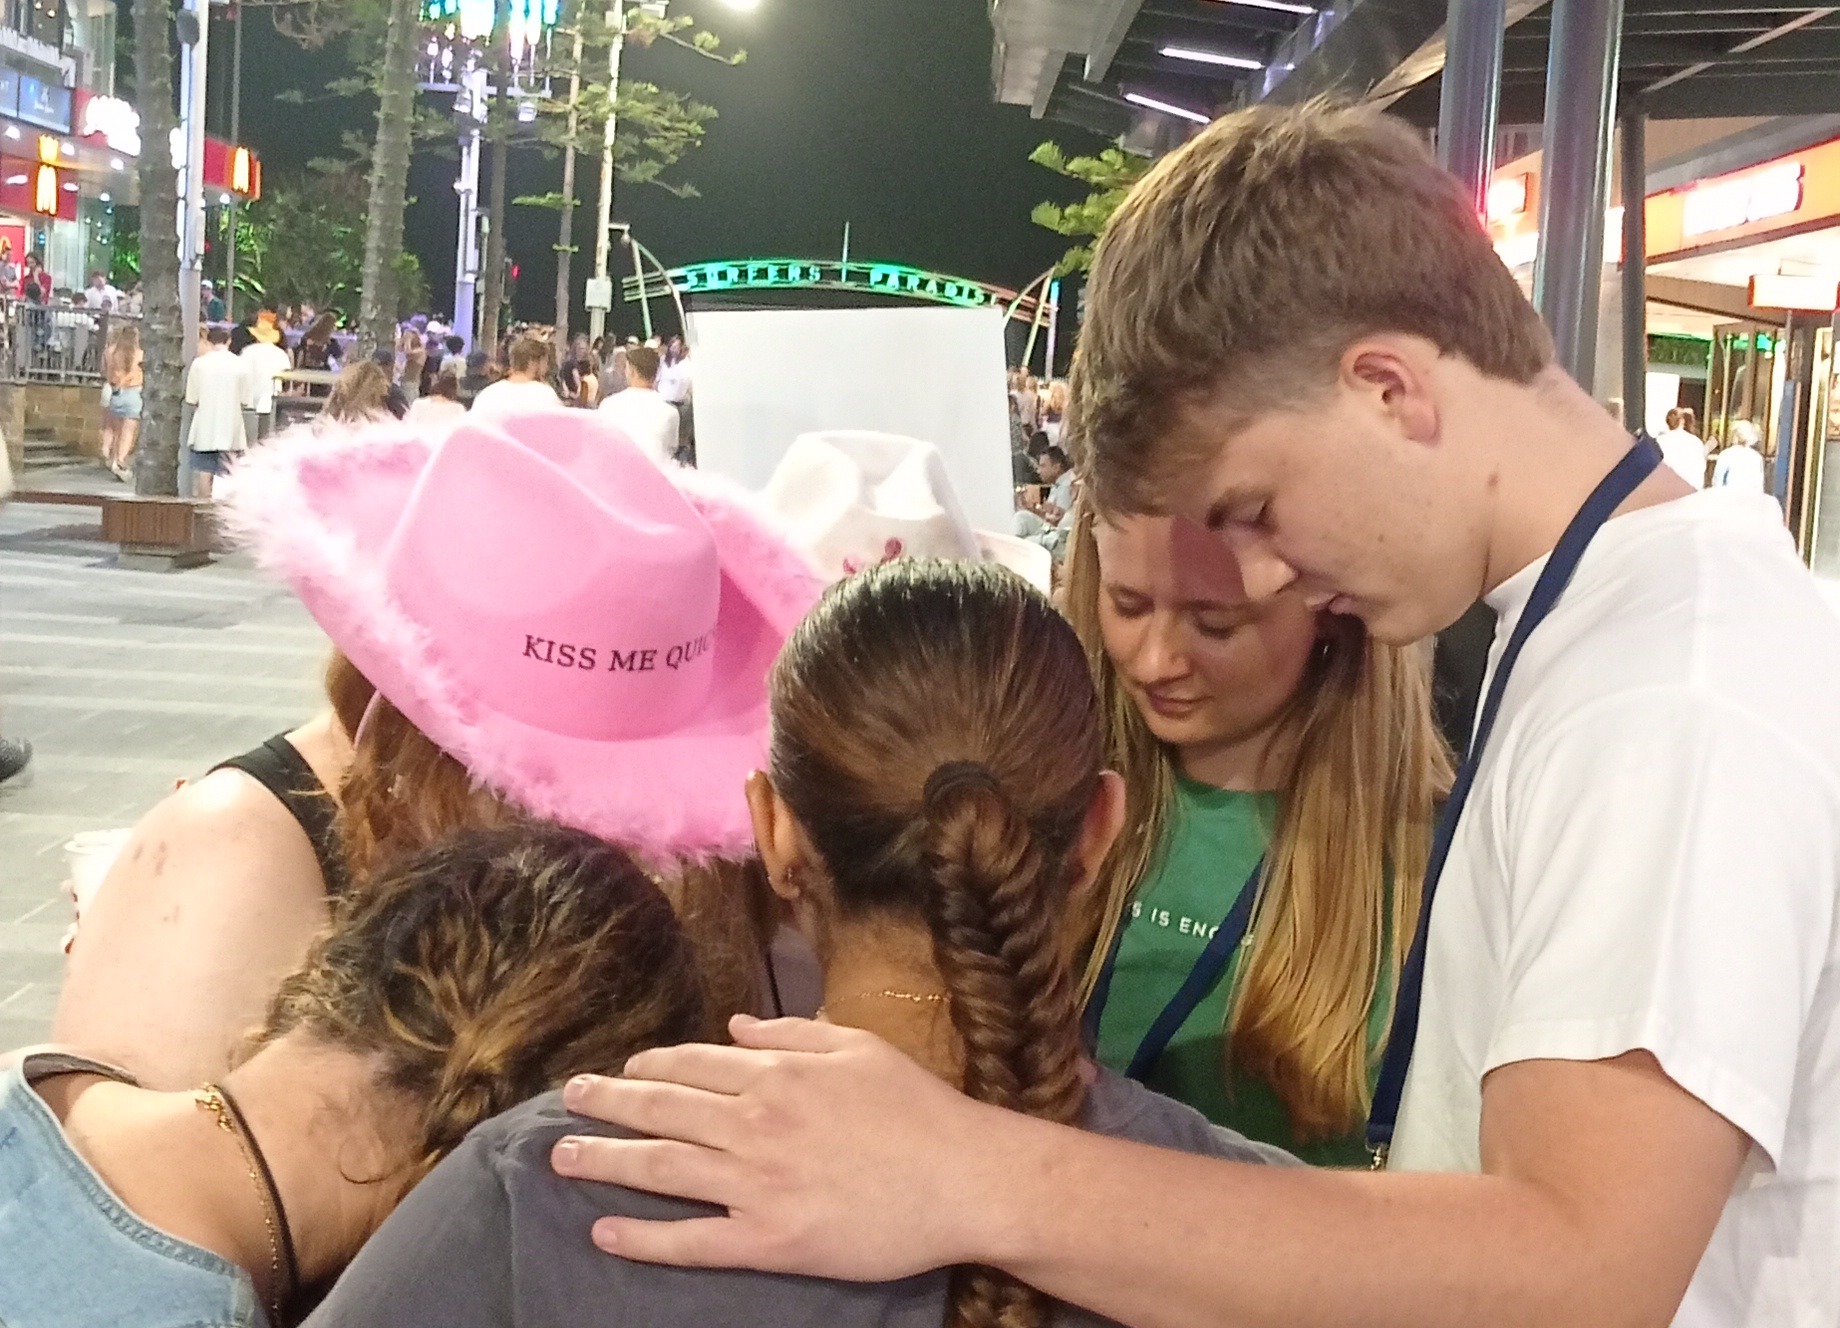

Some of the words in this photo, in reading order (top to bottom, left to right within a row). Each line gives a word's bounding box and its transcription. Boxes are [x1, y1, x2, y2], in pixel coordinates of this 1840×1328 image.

[686, 264, 821, 289] SURFERS
[523, 634, 597, 670] KISS
[608, 648, 657, 672] ME
[666, 628, 714, 670] QUIC
[1151, 907, 1170, 927] IS
